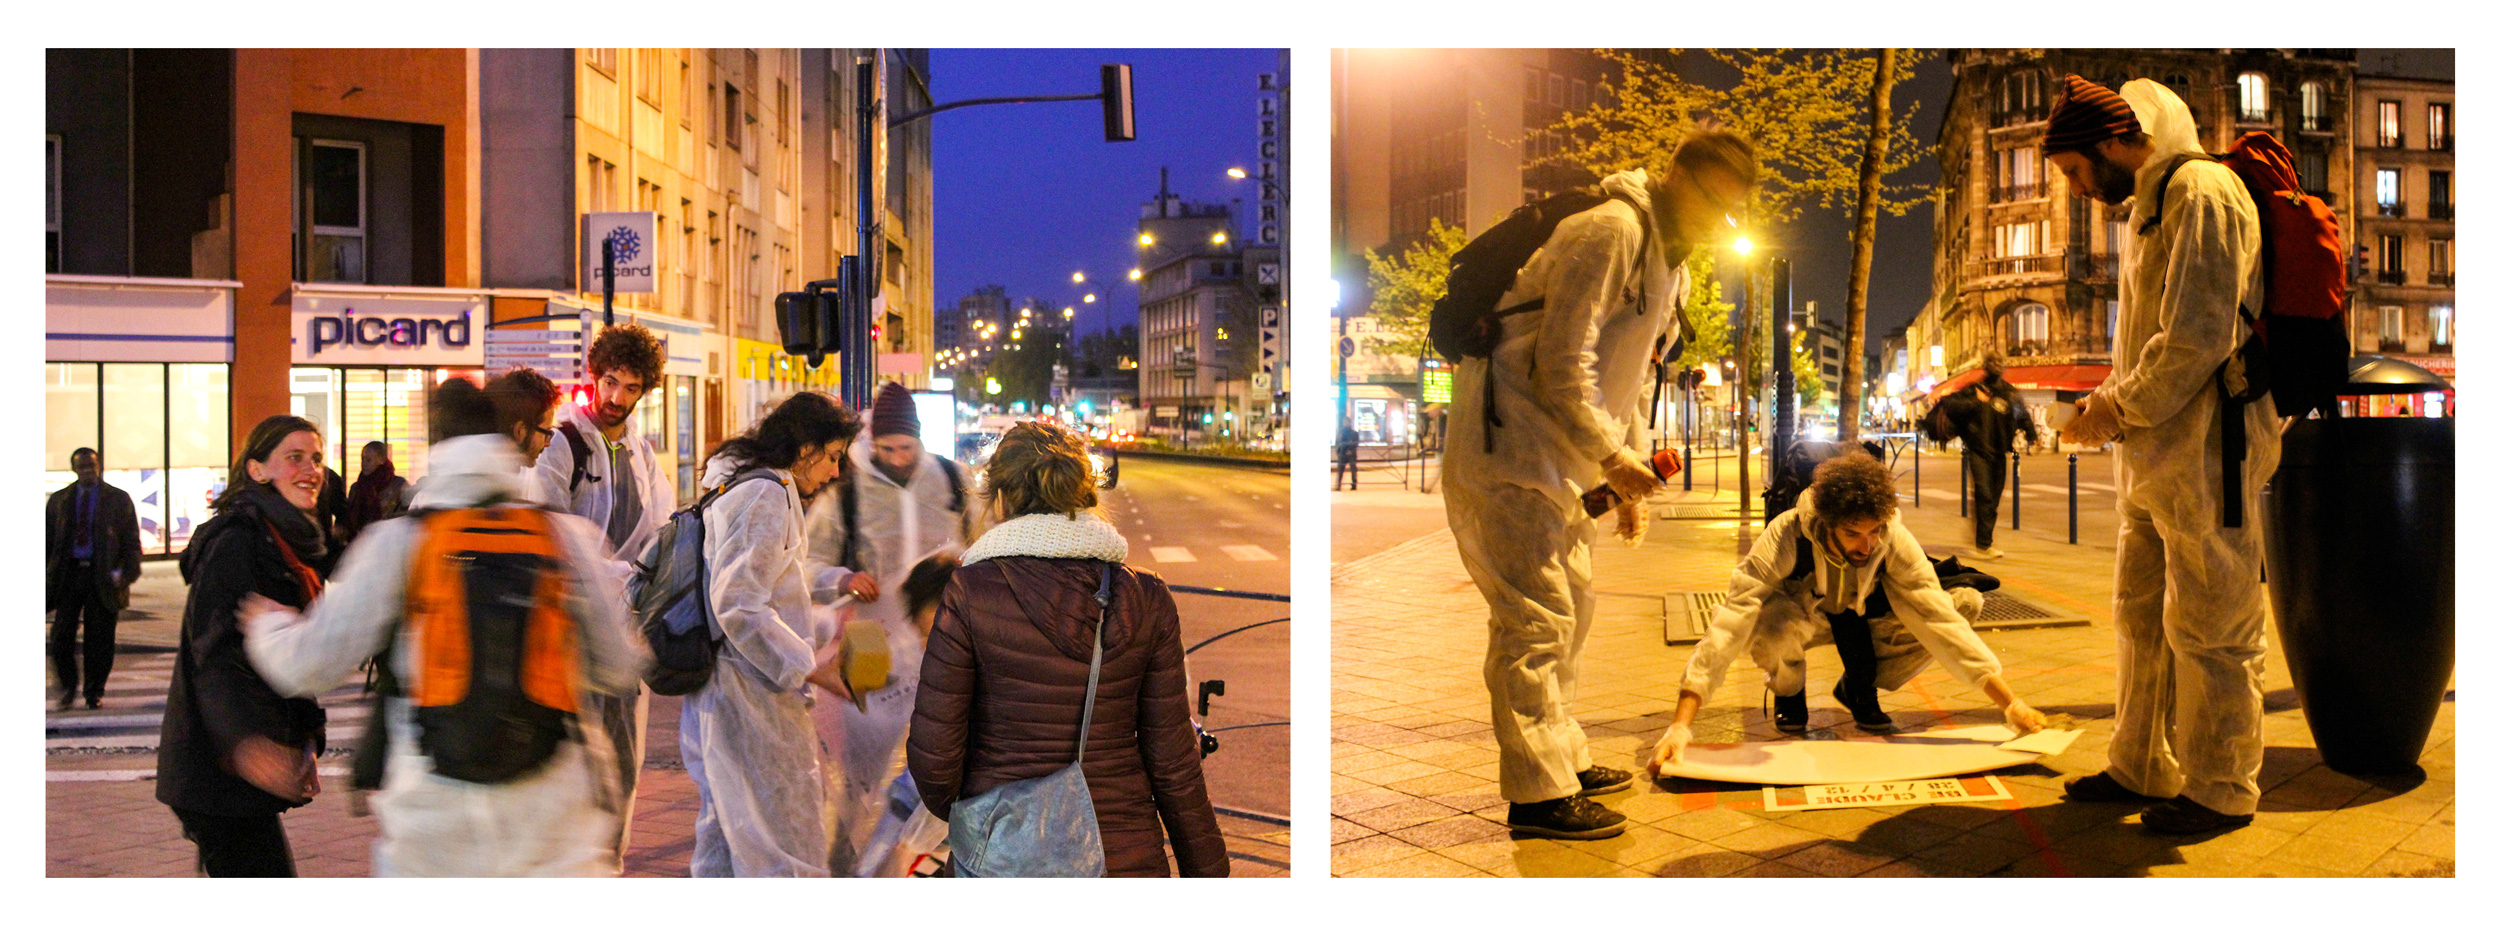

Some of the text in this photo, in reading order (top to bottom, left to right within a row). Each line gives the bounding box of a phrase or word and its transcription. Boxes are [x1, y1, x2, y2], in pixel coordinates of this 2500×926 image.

[1261, 98, 1276, 243] LECLERC
[594, 264, 651, 280] pcard
[314, 308, 471, 354] picard
[1816, 792, 1917, 805] CLAUDE
